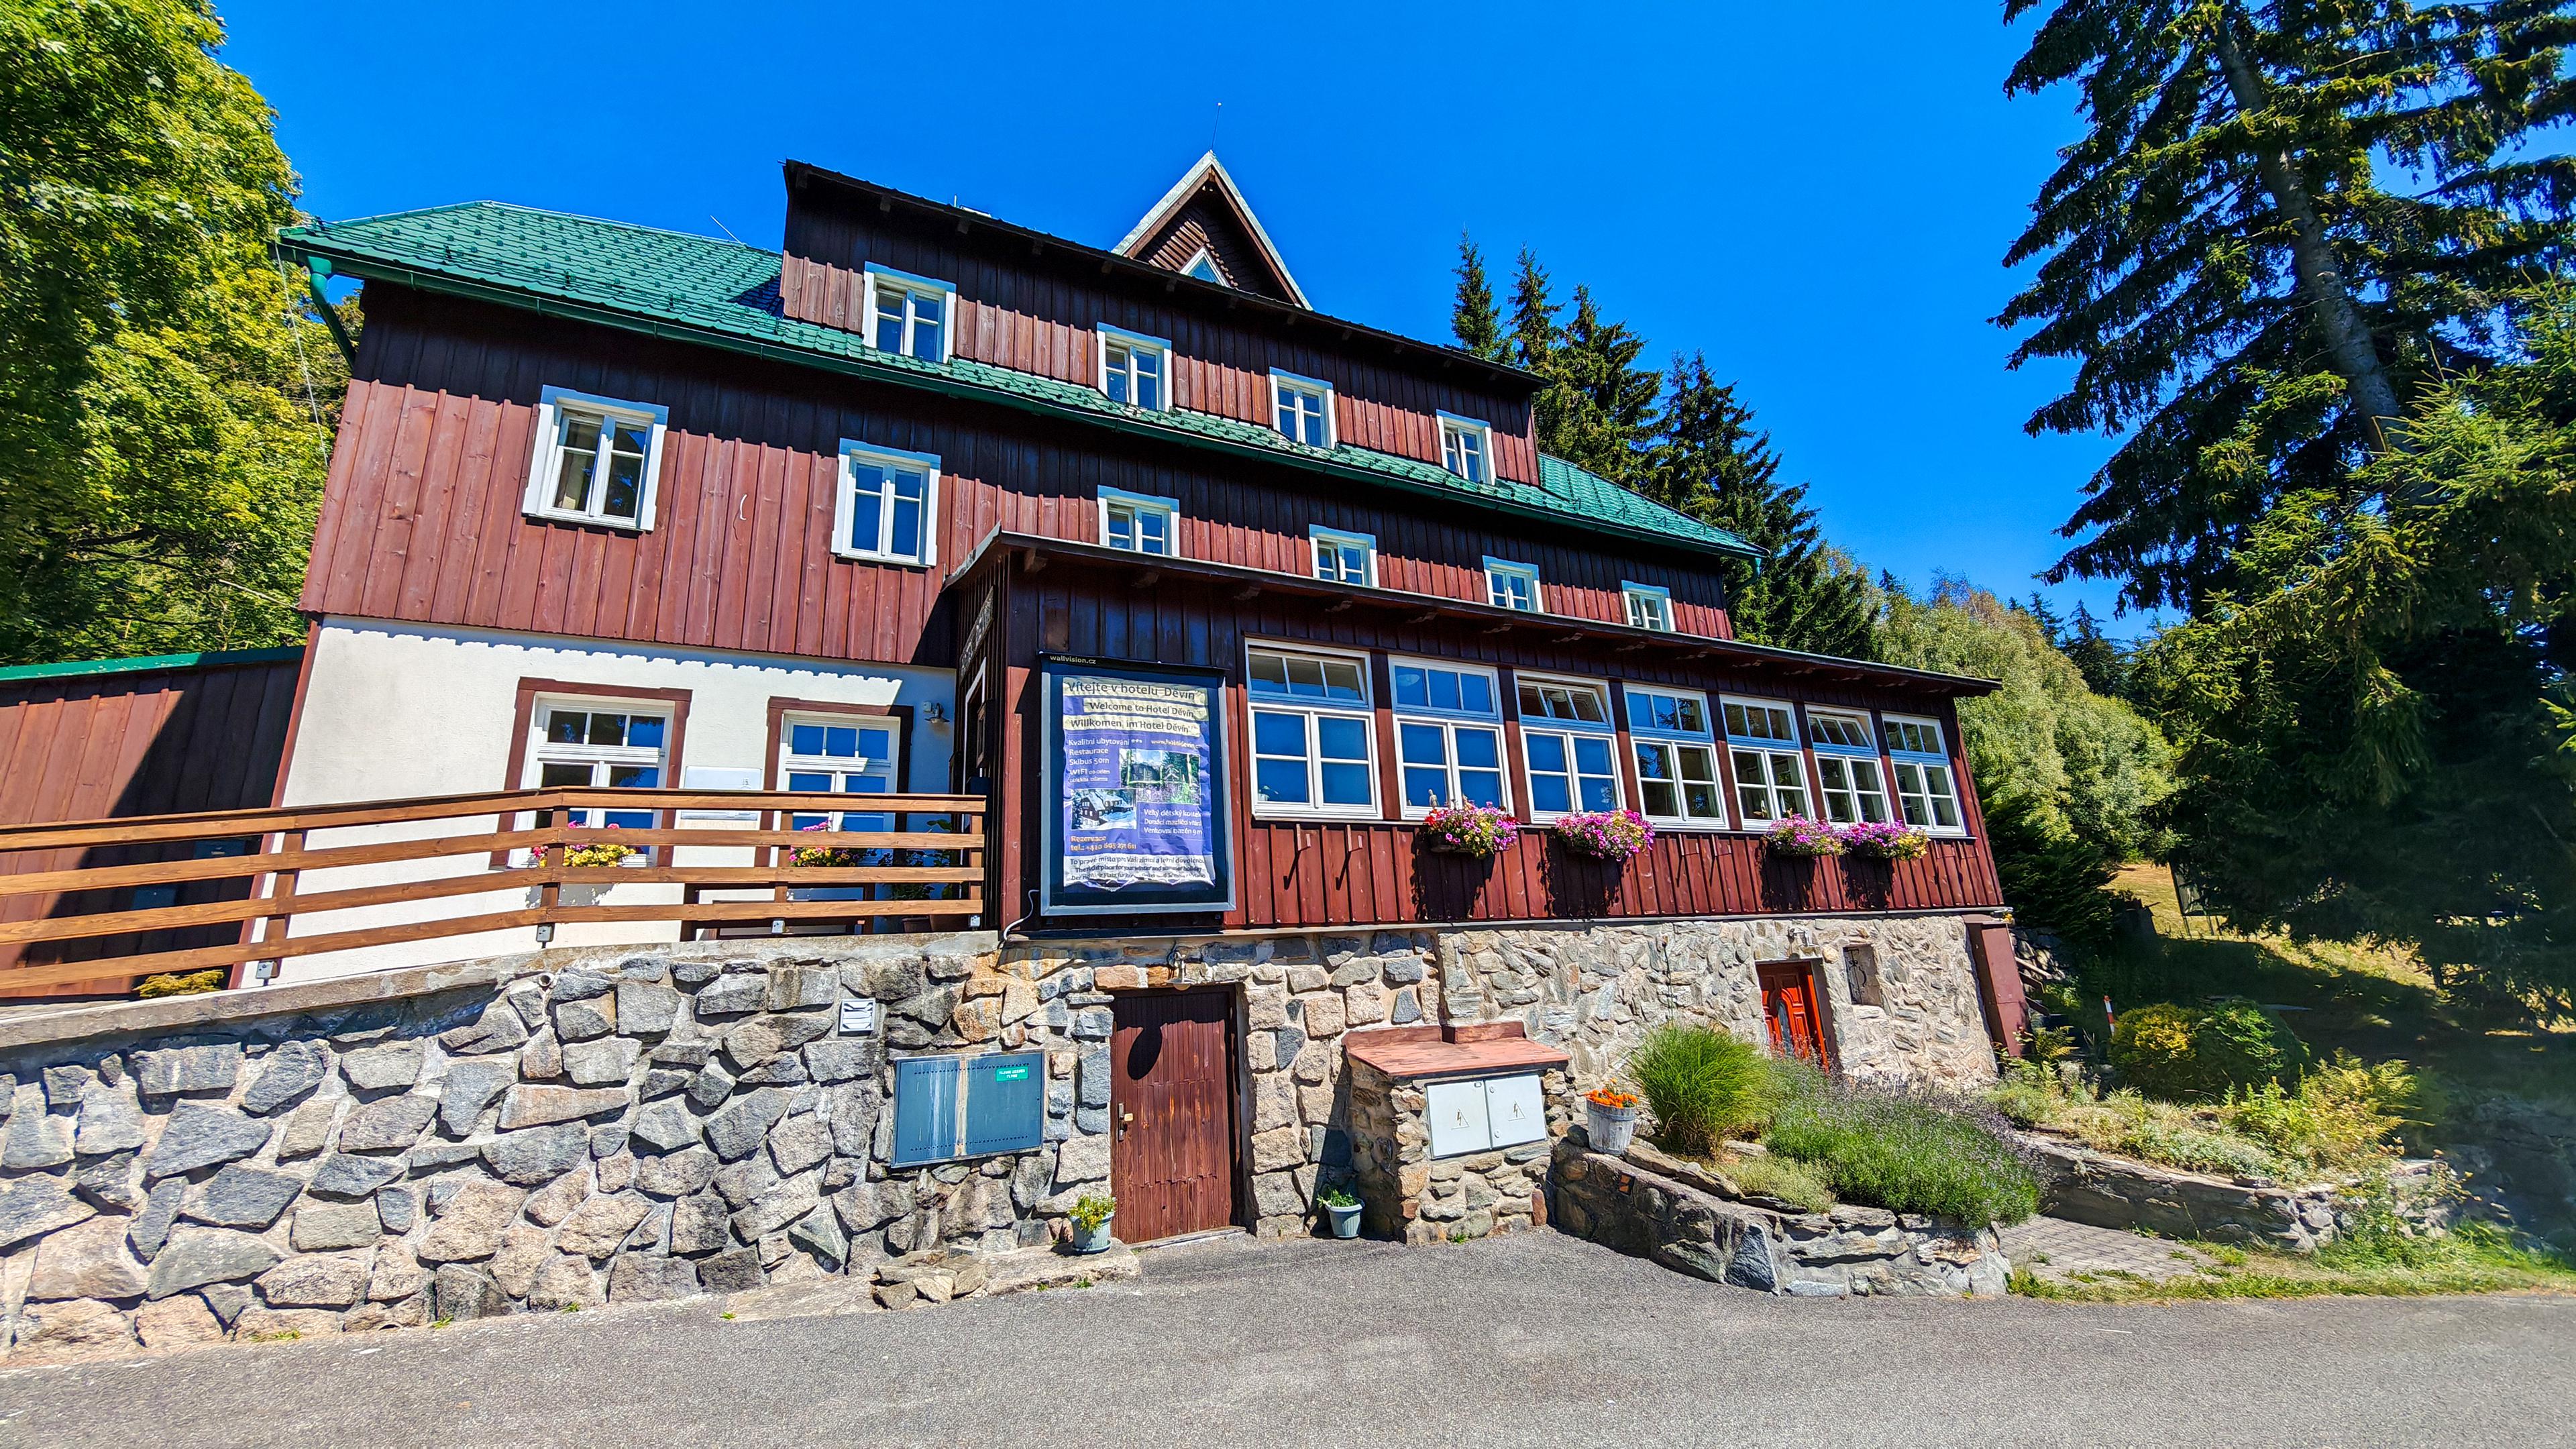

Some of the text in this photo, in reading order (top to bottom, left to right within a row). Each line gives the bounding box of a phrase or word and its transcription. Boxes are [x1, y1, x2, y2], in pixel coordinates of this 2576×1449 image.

[1050, 655, 1096, 664] wallvision.cz
[1069, 681, 1107, 694] Vítejte
[1121, 683, 1157, 696] hotelu
[1089, 702, 1132, 711] Welcome
[1146, 705, 1169, 714] Hotel
[1071, 718, 1122, 727] Willkomen
[1140, 720, 1163, 730] Hotel
[1069, 748, 1108, 756] Restaurace
